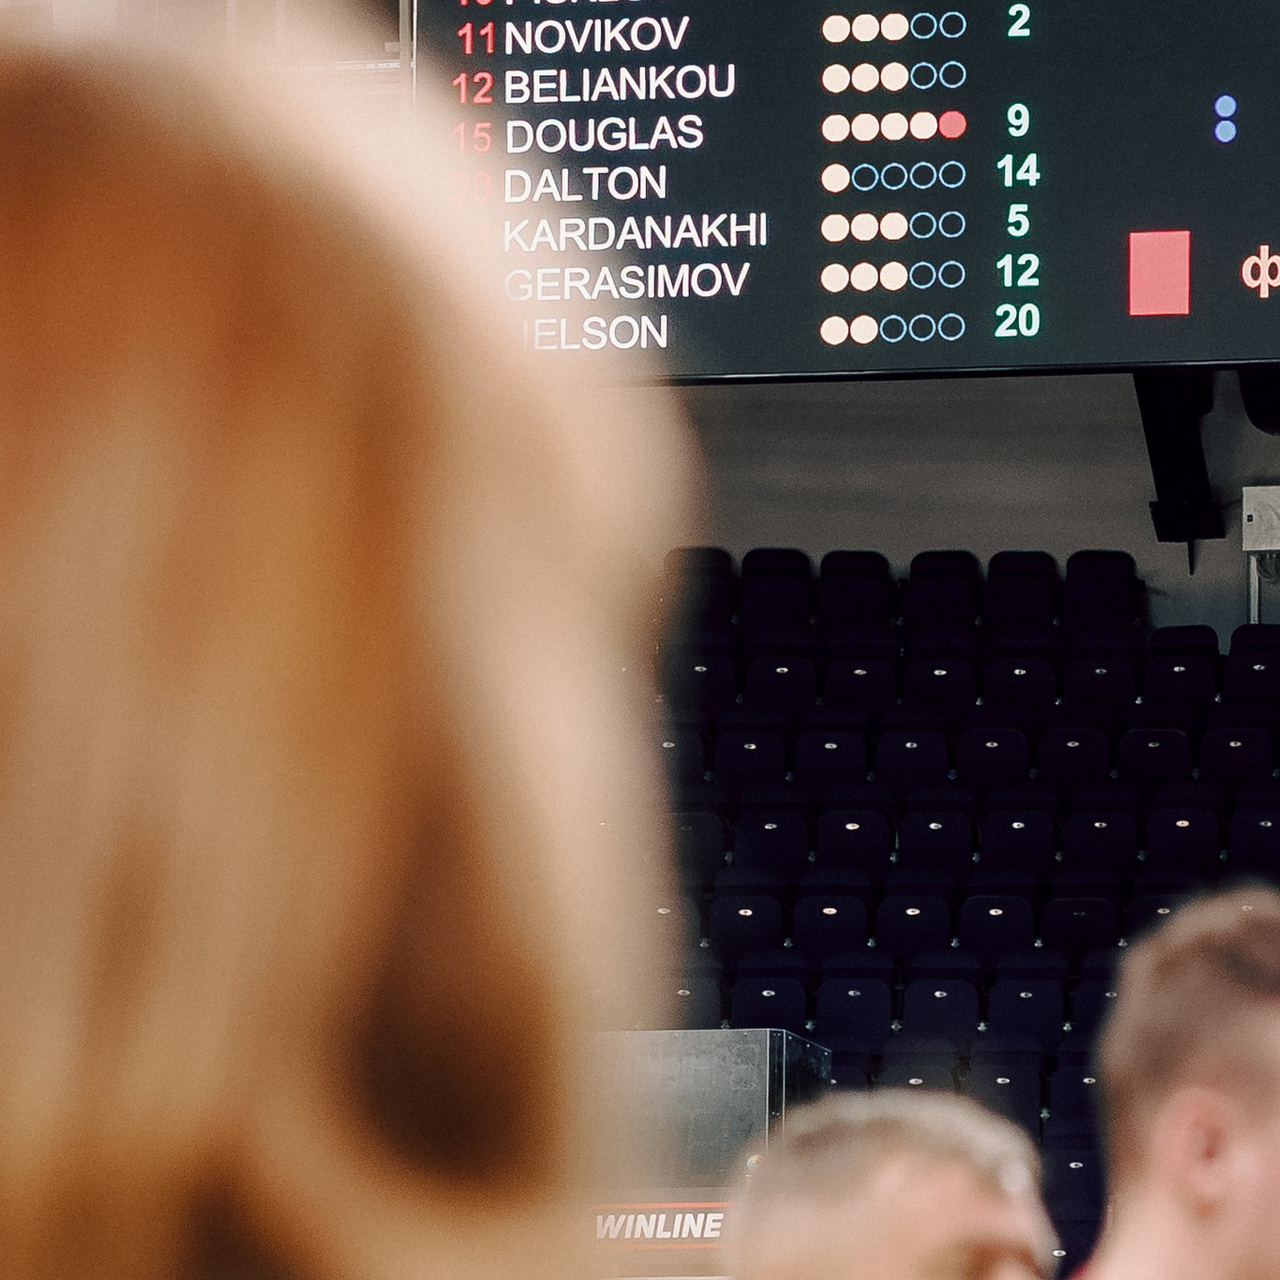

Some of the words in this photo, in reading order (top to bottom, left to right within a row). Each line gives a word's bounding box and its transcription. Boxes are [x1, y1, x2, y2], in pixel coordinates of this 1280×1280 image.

[456, 21, 494, 55] 11
[505, 15, 690, 55] NOVIKOV
[1007, 3, 1031, 37] 2
[452, 73, 493, 105] 12
[504, 63, 735, 104] BELIANKOU
[506, 116, 703, 154] DOUGLAS
[1007, 103, 1030, 137] 9
[504, 166, 666, 203] DALTON
[996, 152, 1041, 188] 14
[504, 213, 766, 253] KARDANAKHI
[1006, 203, 1030, 238] 5
[504, 264, 749, 302] GERASIMOV
[996, 253, 1040, 288] 12
[994, 302, 1040, 338] 20
[596, 1213, 724, 1239] WINLINE
